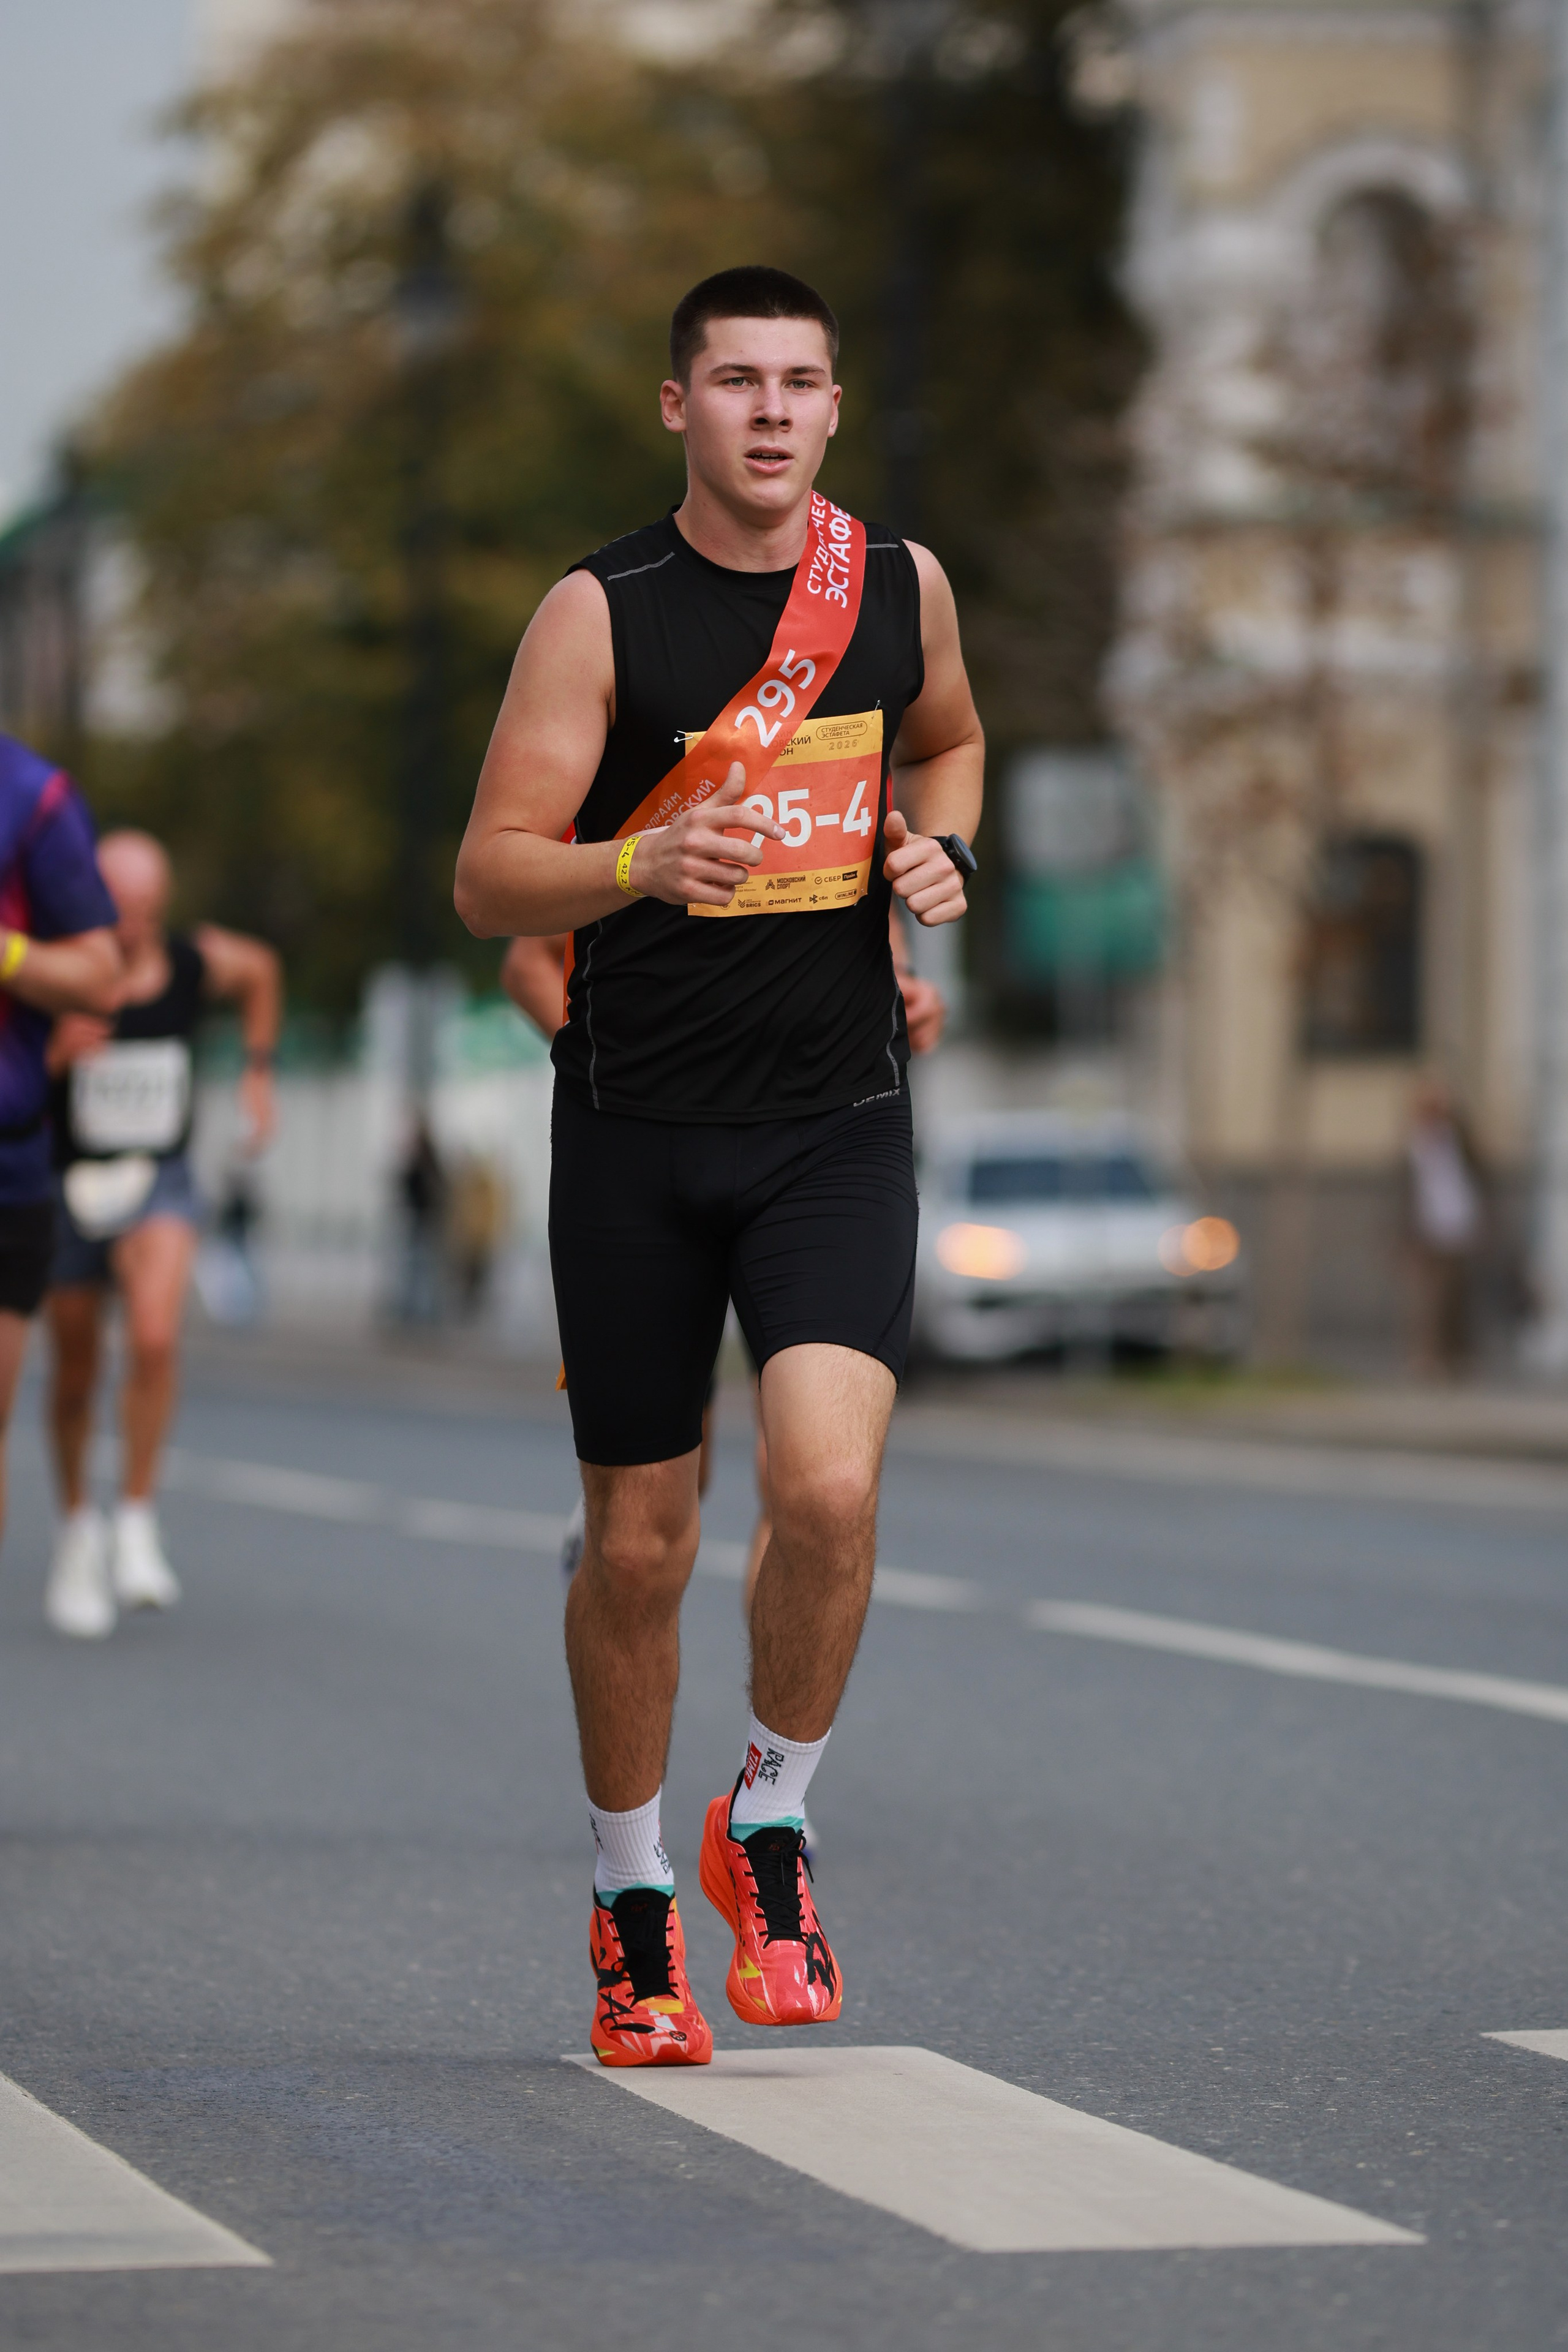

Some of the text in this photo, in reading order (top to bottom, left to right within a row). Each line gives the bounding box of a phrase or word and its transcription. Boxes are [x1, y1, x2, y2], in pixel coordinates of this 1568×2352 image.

[734, 649, 816, 748] 295
[821, 723, 863, 733] СТУДЕНЧЕСКАЯ
[643, 791, 682, 831] РПРАЙМ
[663, 778, 716, 826] ОВСКИЙ
[777, 875, 806, 884] МОСКОВСКИЙ
[744, 1751, 759, 1784] TIME
[758, 1747, 785, 1785] RACE
